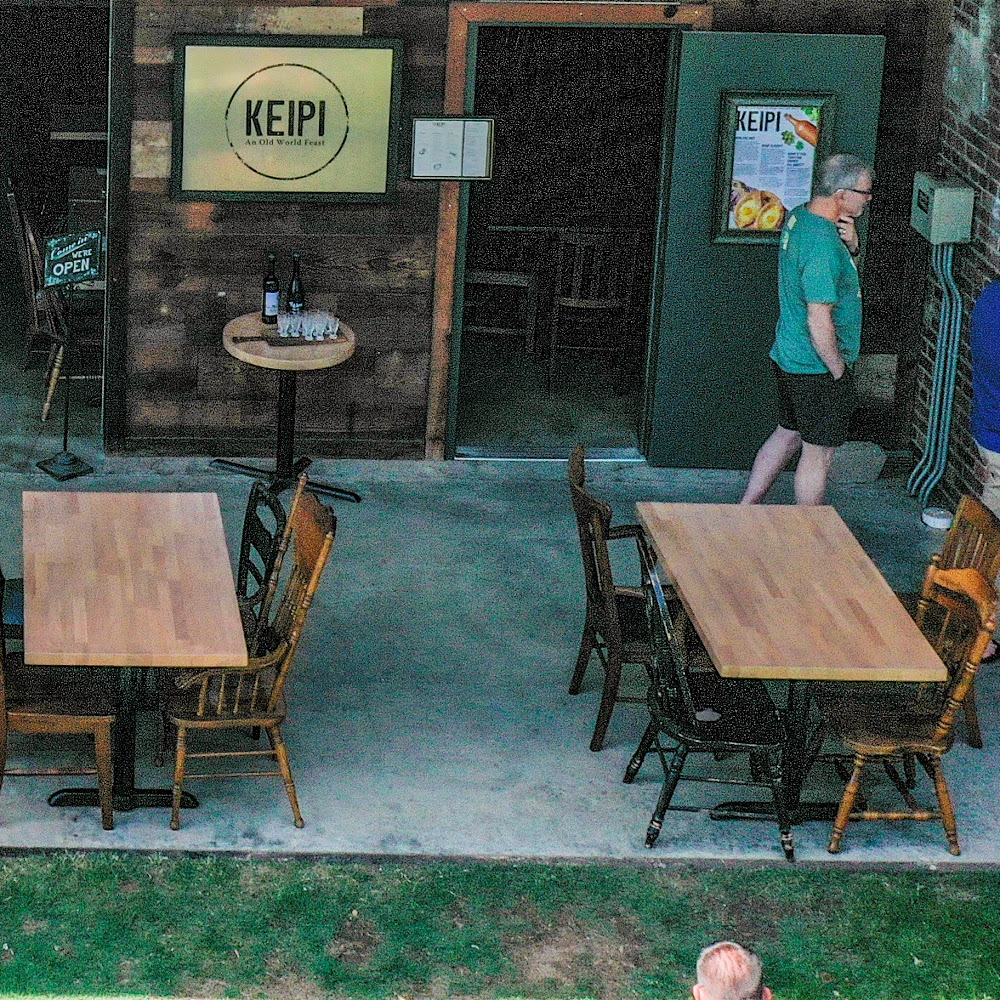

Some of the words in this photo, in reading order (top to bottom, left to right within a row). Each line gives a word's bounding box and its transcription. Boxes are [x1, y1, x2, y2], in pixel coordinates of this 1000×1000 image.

[245, 99, 326, 137] KEIPI
[736, 110, 781, 132] KEIPI
[245, 138, 257, 146] An
[259, 138, 274, 146] Old
[276, 138, 302, 146] World
[304, 138, 325, 146] Feast
[71, 248, 93, 259] WE'RE
[52, 257, 91, 276] OPEN
